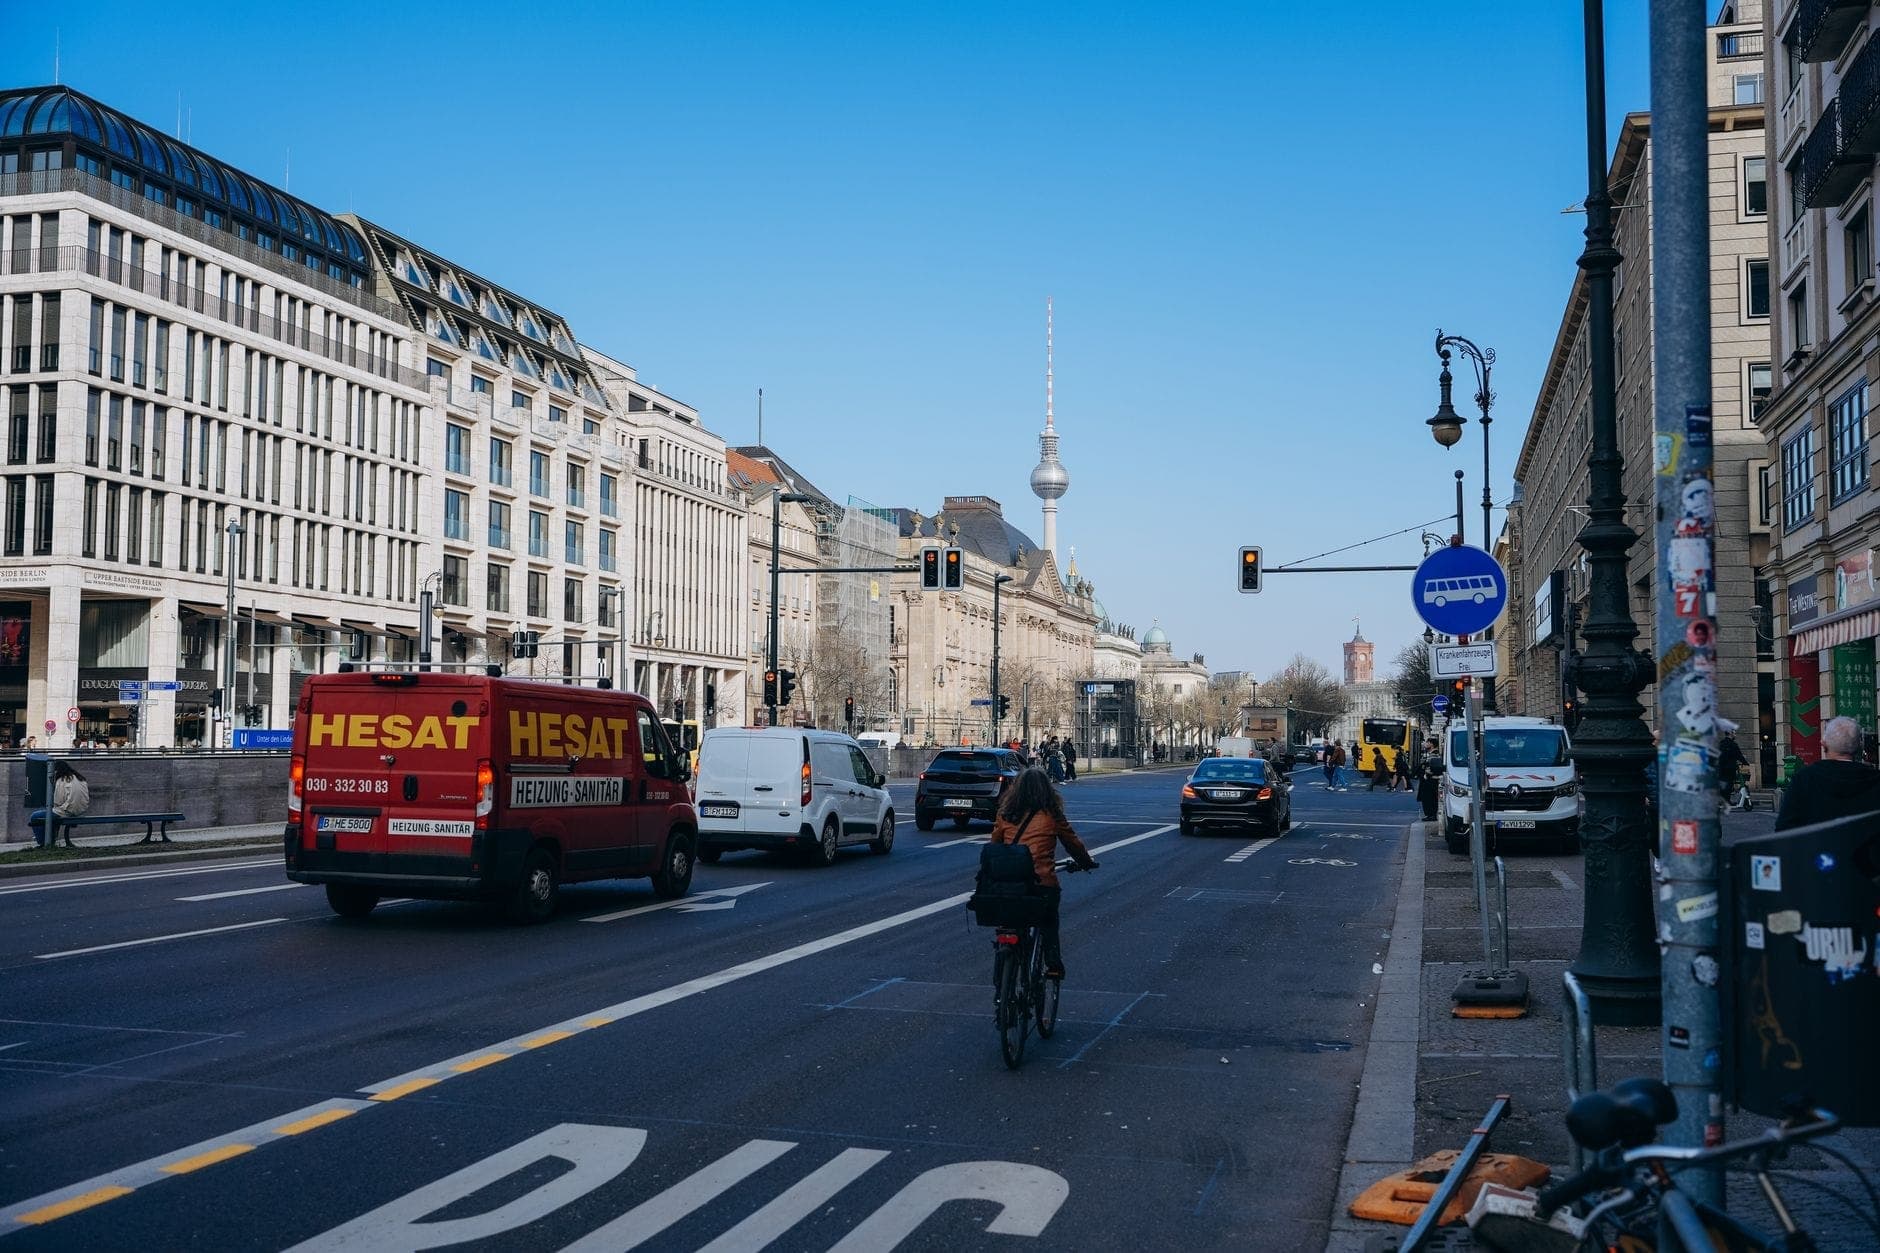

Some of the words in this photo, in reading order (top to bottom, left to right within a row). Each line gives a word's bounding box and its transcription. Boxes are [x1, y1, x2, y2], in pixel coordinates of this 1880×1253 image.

[93, 573, 112, 581] UPPER
[114, 575, 141, 585] EASTSIDE
[142, 578, 162, 587] BERLIN
[1439, 648, 1491, 659] Krankenfahrzeuge
[1458, 662, 1471, 671] Frei
[81, 680, 119, 688] DOUGLAS
[183, 681, 208, 690] OUGLAS
[309, 713, 480, 749] HESAT
[509, 710, 629, 760] HESAT
[240, 733, 247, 745] U
[256, 735, 270, 743] Unter
[270, 735, 279, 743] den
[280, 735, 293, 743] Linde
[306, 778, 327, 791] 030
[335, 779, 356, 792] 332
[358, 779, 372, 793] 30
[375, 780, 389, 794] 83
[323, 817, 330, 828] B
